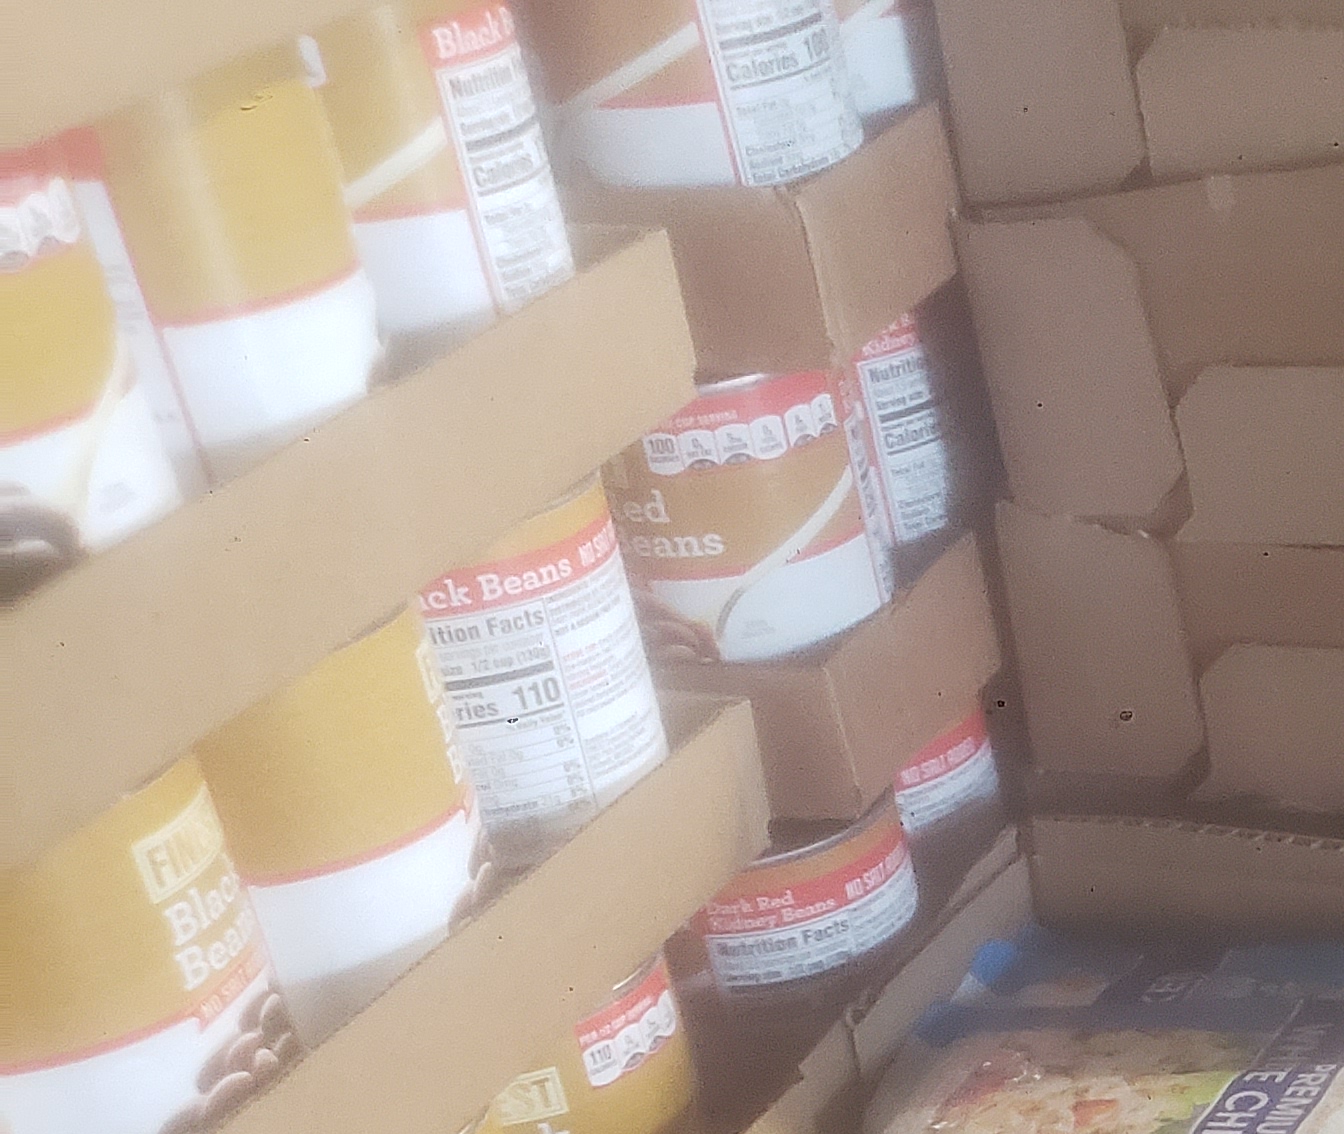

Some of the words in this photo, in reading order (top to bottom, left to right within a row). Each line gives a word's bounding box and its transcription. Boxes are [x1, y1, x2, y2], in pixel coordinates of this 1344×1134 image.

[431, 20, 502, 60] Black
[726, 52, 796, 82] Calories
[625, 490, 670, 523] ed
[628, 530, 725, 558] eans
[477, 558, 572, 601] Beans
[485, 606, 545, 638] Facts
[511, 676, 561, 711] 110
[706, 900, 754, 917] Dark
[756, 890, 794, 909] Red
[708, 914, 776, 931] Kidney
[781, 897, 838, 922] Beans
[715, 937, 798, 956] Nutrition
[800, 919, 849, 945] Facts
